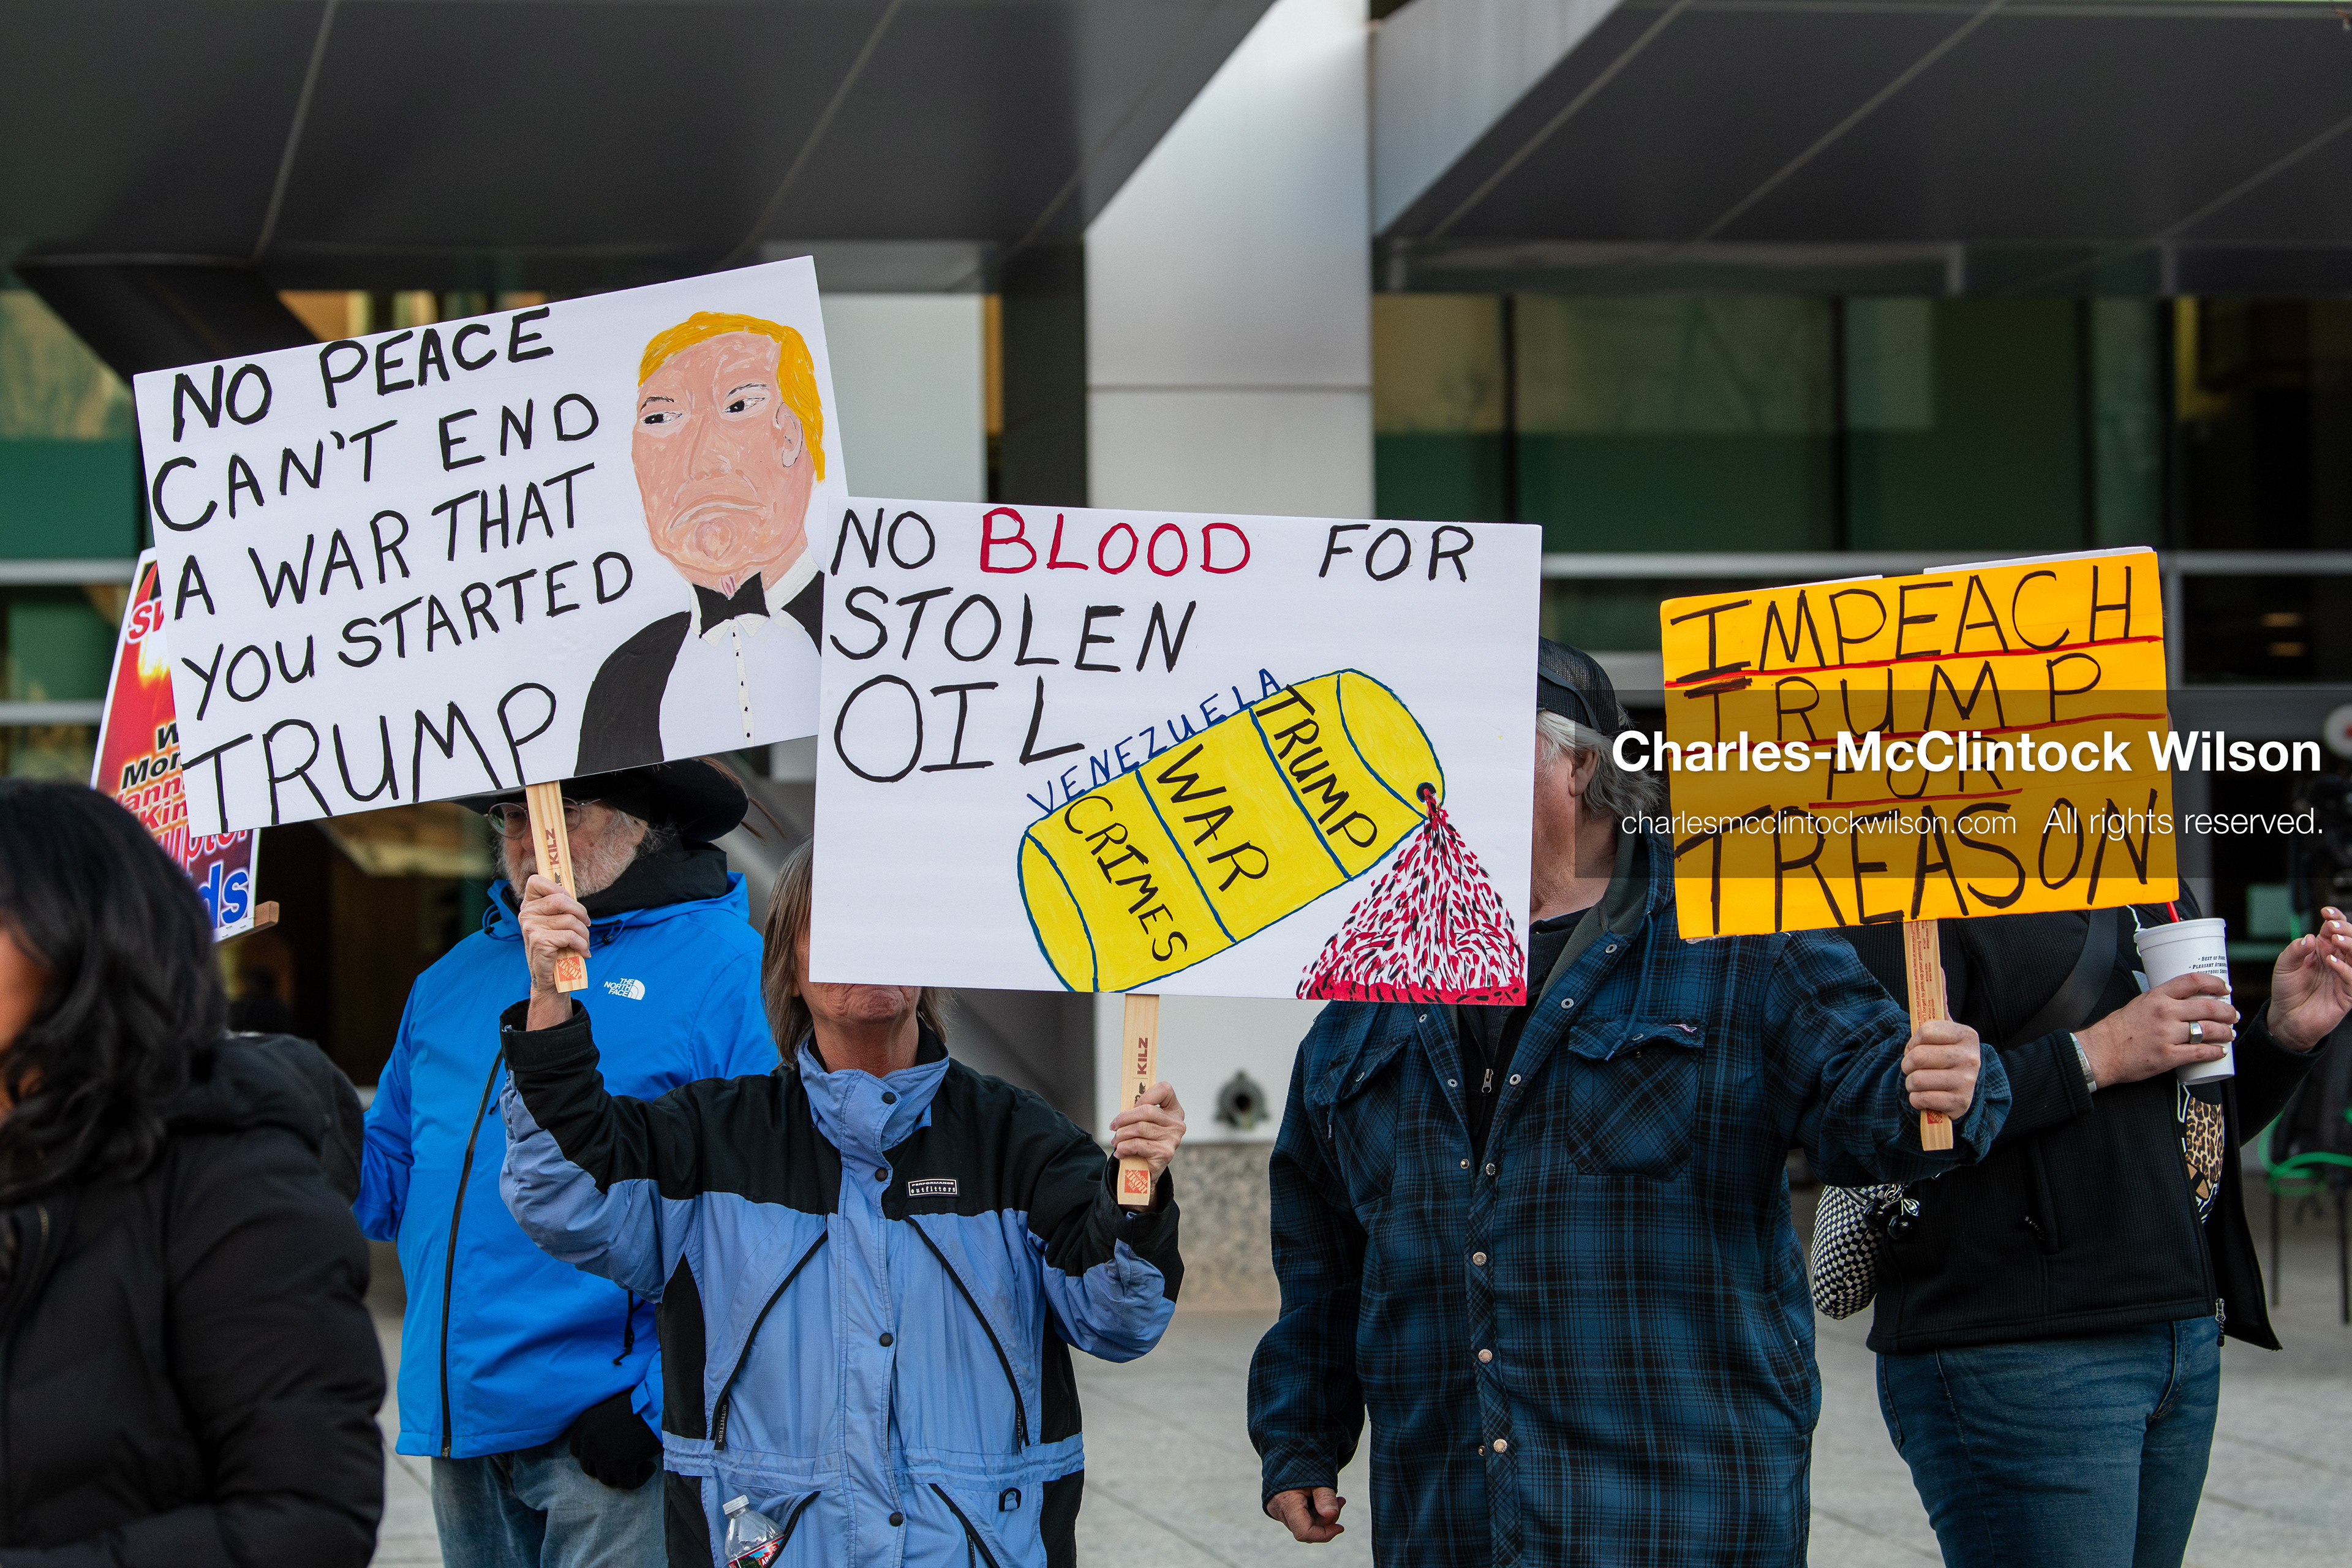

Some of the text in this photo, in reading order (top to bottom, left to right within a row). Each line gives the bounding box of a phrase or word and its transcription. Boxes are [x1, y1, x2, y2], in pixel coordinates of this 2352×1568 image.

[173, 307, 554, 442] NO PEACE
[152, 393, 599, 532] CAN'T END
[175, 554, 215, 620] A
[247, 510, 410, 608] WAR
[431, 462, 595, 560] THAT
[830, 507, 1474, 582] NO BLOOD FOR
[181, 551, 633, 721] YOU STARTED
[829, 586, 1196, 673] STOLEN
[1670, 565, 2134, 683] IMPEACH
[834, 674, 1085, 783] OIL
[1026, 668, 1281, 815] VENEZUELA
[1683, 651, 2102, 748] TRUMP
[180, 682, 557, 834] TRUMP
[1254, 684, 1378, 848] TRUMP
[545, 827, 560, 865] KILZ
[1155, 743, 1269, 892] WAR
[1675, 788, 2158, 936] TREASON
[1064, 794, 1189, 963] CRIMES
[562, 970, 570, 978] THE
[603, 981, 631, 991] NORTH
[608, 988, 629, 997] FACE
[1137, 1037, 1148, 1075] KILZ
[1127, 1182, 1136, 1191] THE
[718, 1404, 727, 1443] OUTFITTERS
